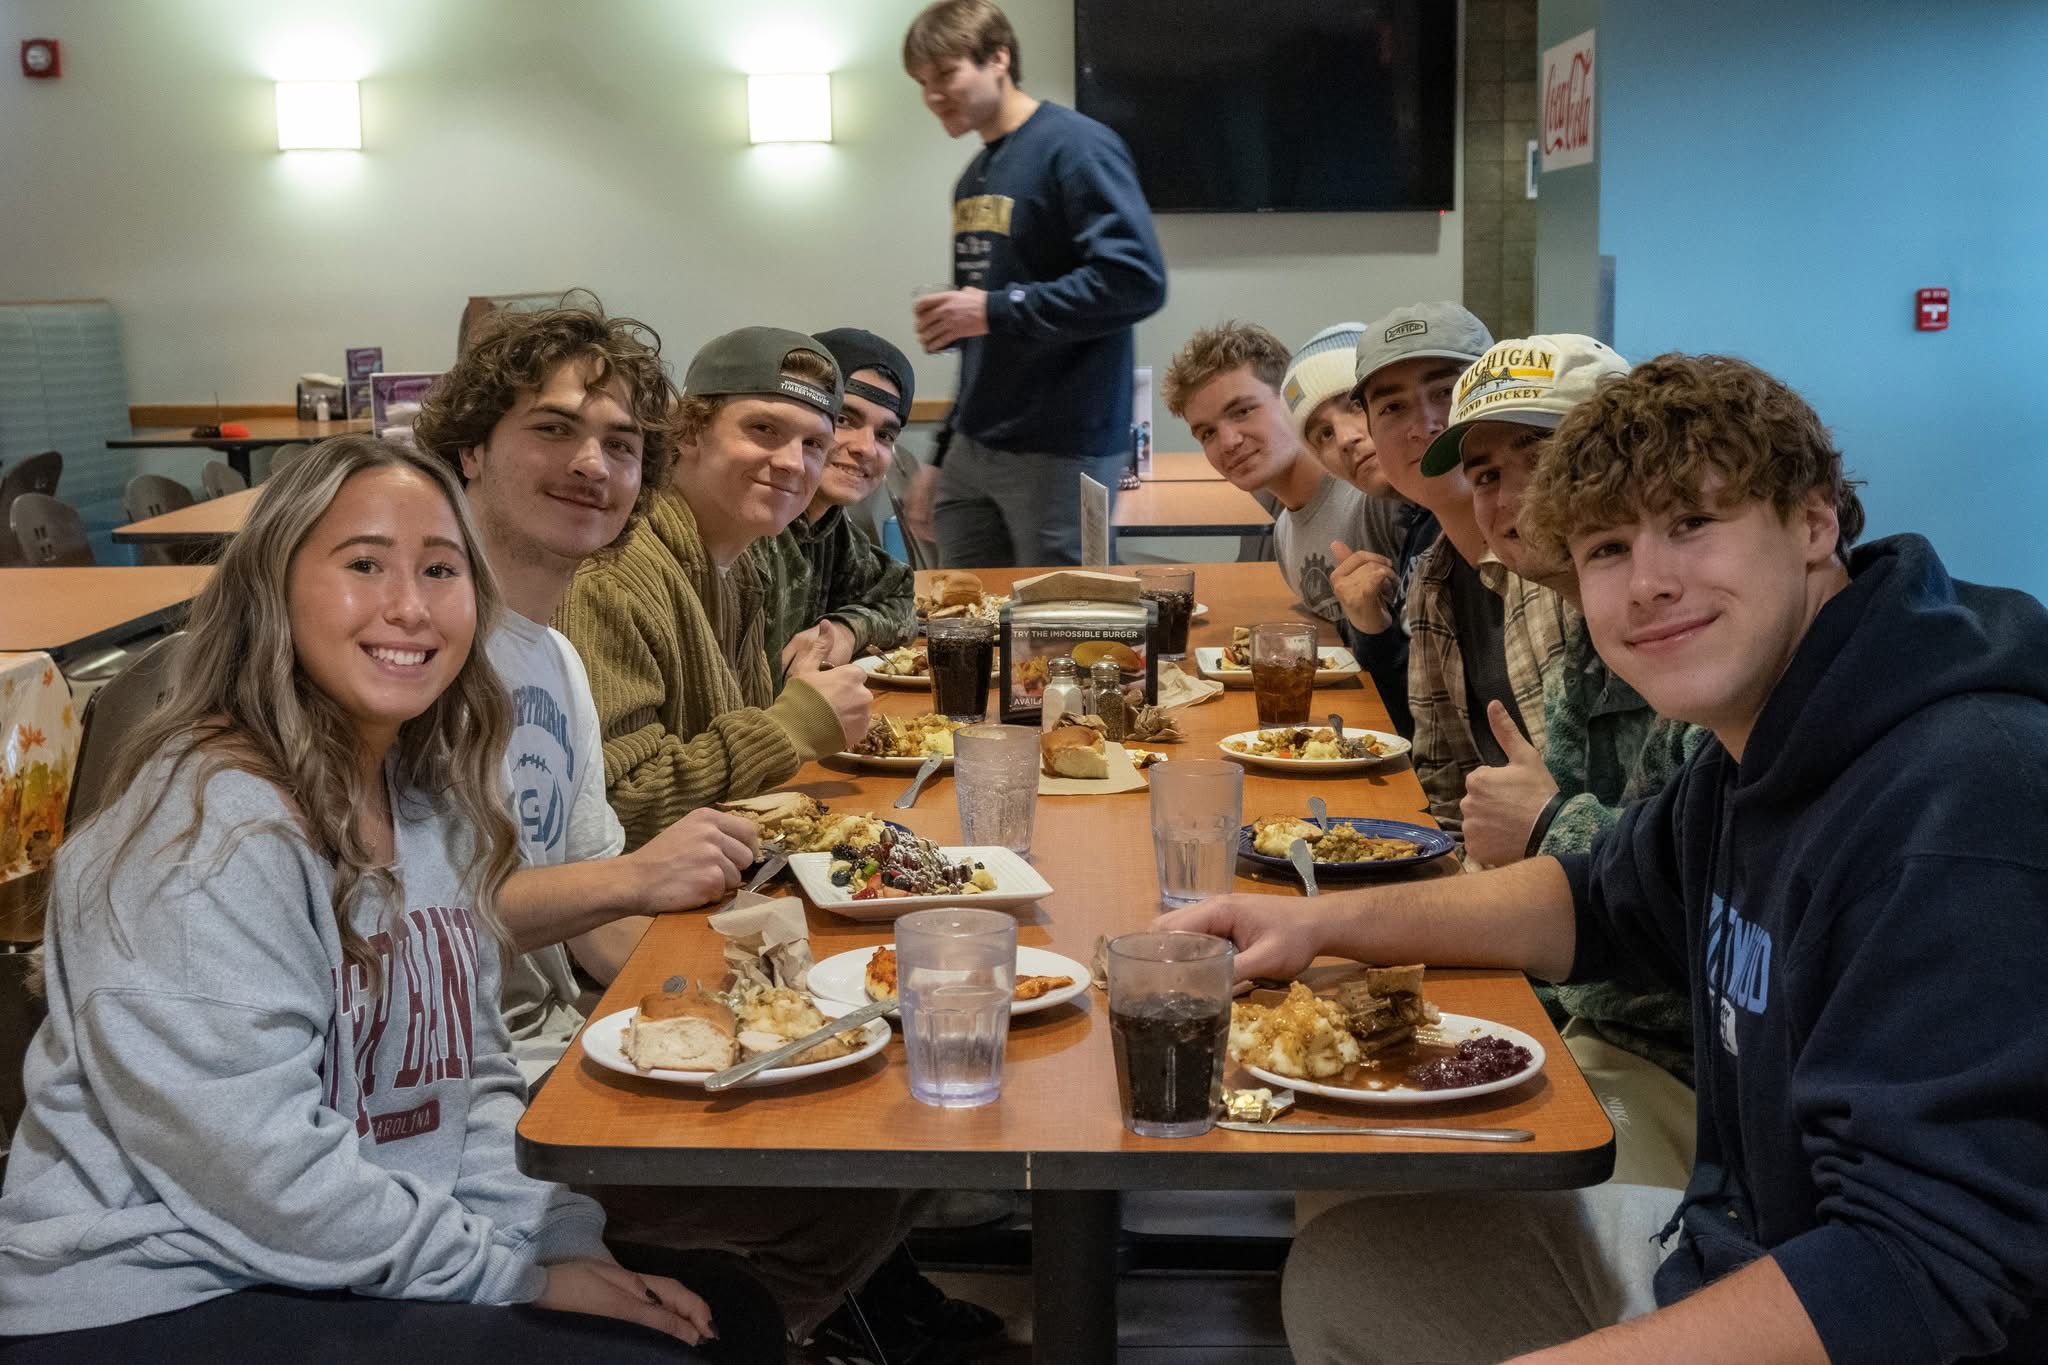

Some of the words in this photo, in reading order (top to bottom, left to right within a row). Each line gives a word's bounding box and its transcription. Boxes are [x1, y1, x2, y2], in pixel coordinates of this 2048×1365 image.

[1461, 349, 1552, 391] MICHIGAN
[1459, 399, 1481, 421] POND
[1486, 389, 1541, 404] HOCKEY
[1013, 630, 1029, 638] TRY
[1031, 630, 1048, 638] THE
[1050, 630, 1100, 639] IMPOSSIBLE
[1102, 630, 1138, 639] BURGER
[373, 1107, 431, 1138] AROLINA
